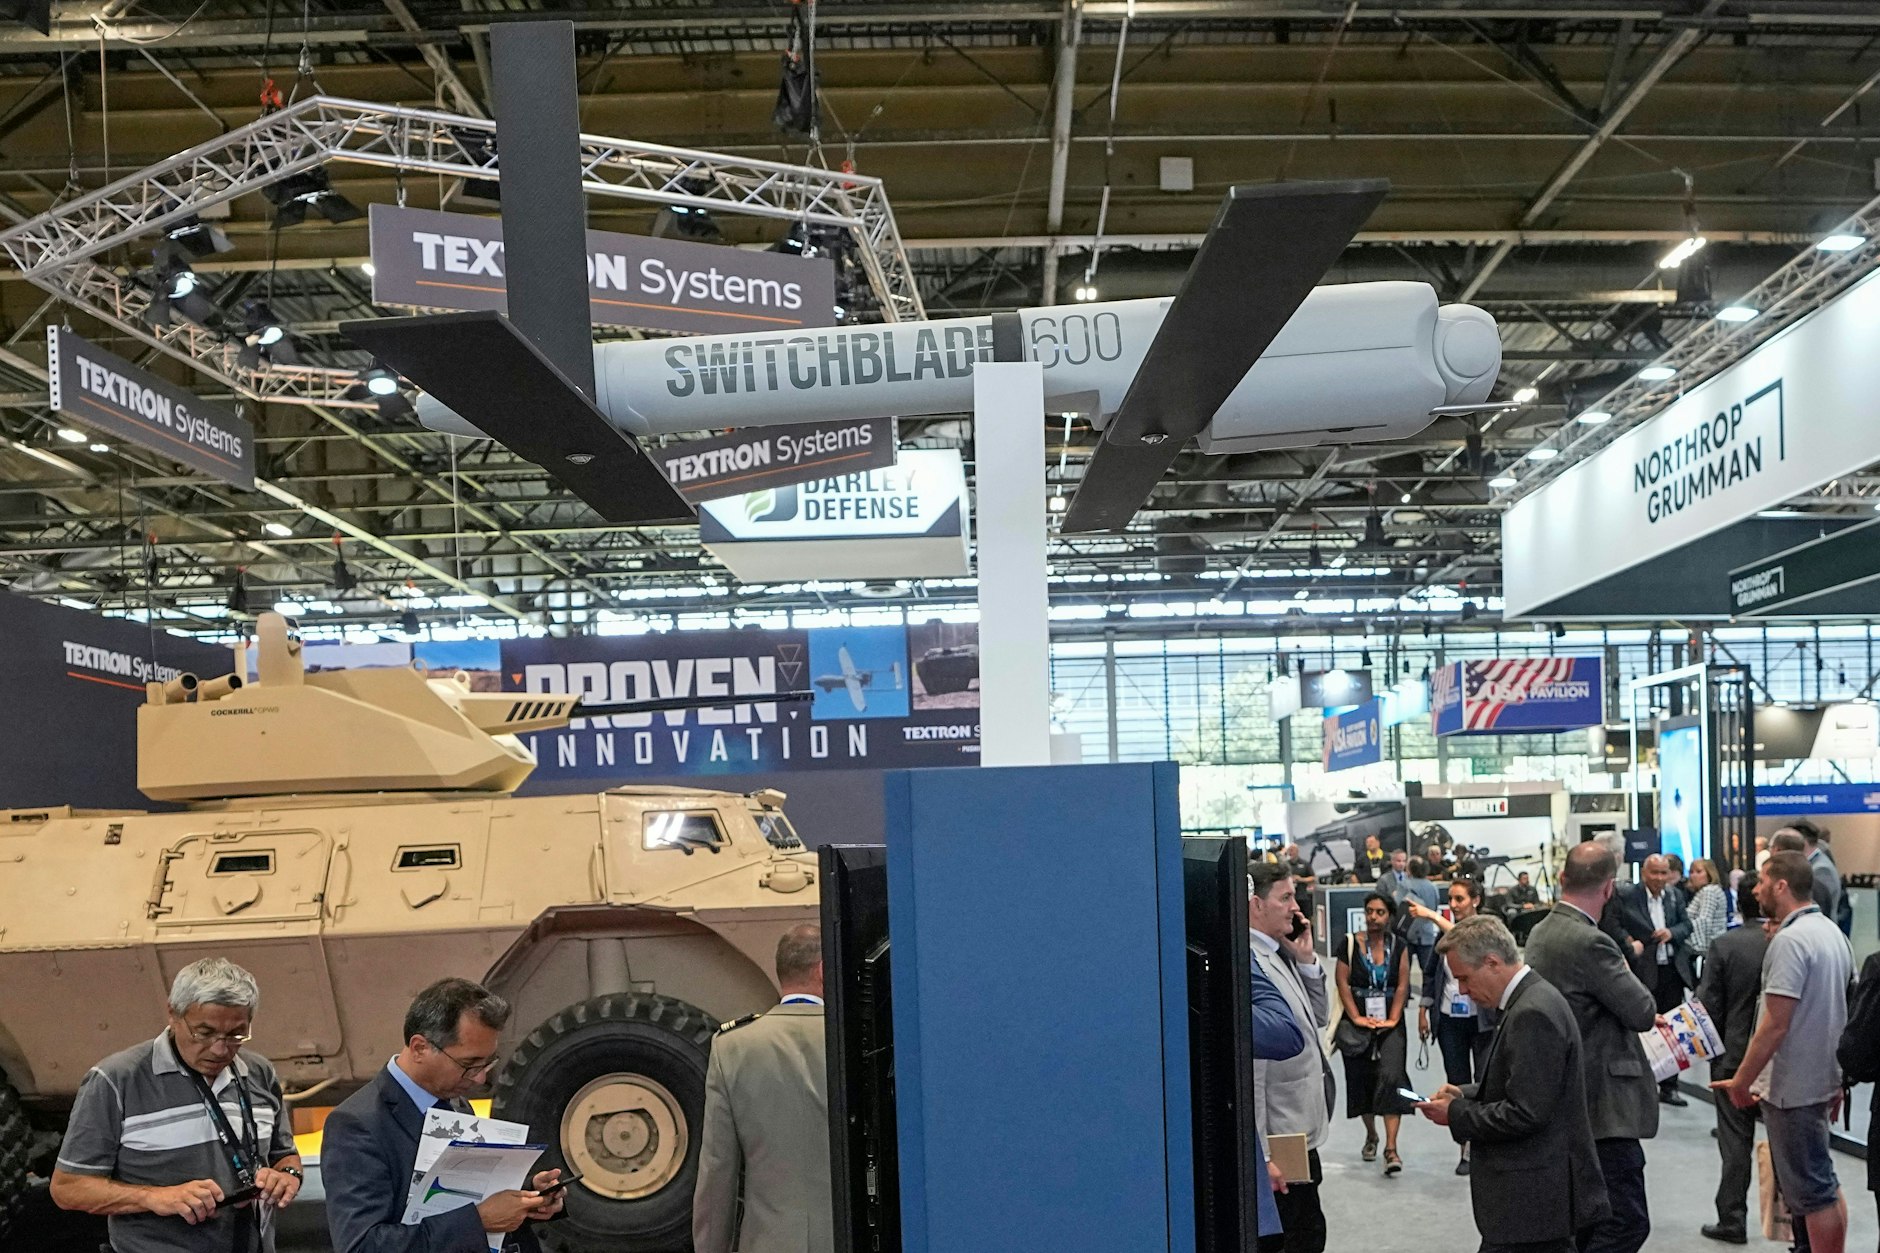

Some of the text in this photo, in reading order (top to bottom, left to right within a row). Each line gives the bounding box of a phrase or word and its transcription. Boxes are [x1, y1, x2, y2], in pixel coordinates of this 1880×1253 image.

[413, 232, 803, 310] TEXN Systems
[1030, 312, 1123, 370] 600
[76, 355, 243, 459] TEXTRON Systems
[666, 423, 873, 482] TEXTRON Systems
[1635, 403, 1742, 493] NORTHROP
[805, 496, 919, 521] DEFENSE
[1648, 436, 1762, 523] GRUMMAN
[63, 640, 132, 676] TEXTRON
[210, 708, 254, 716] COCKERILL
[1530, 686, 1590, 699] PAVILION
[902, 725, 971, 740] TEXTRON
